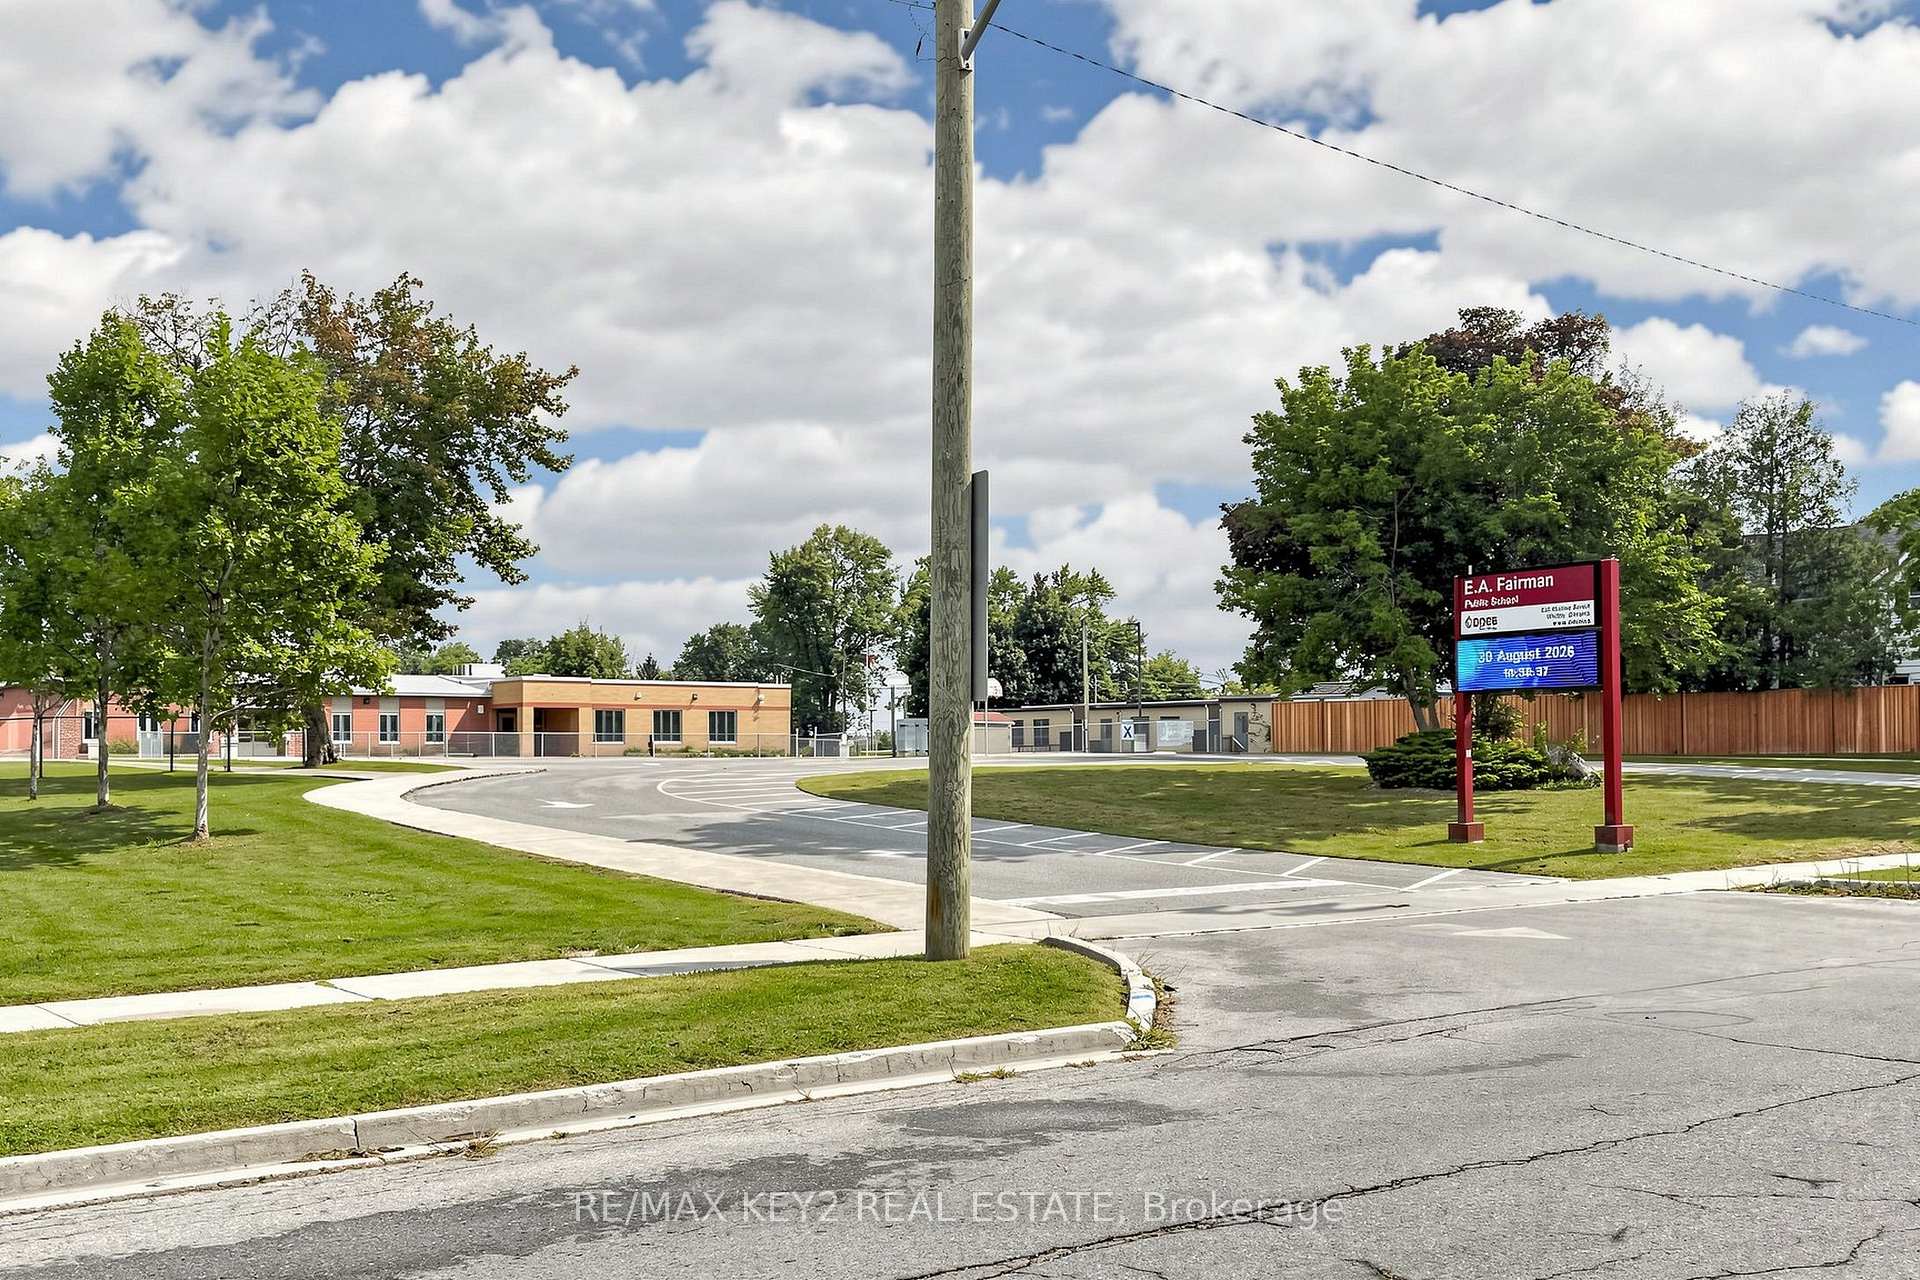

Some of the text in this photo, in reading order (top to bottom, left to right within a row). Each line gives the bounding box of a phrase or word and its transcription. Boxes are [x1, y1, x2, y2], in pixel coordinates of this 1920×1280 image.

[1464, 575, 1554, 596] E.A. Fairman
[1491, 595, 1519, 607] School
[1498, 647, 1541, 664] August
